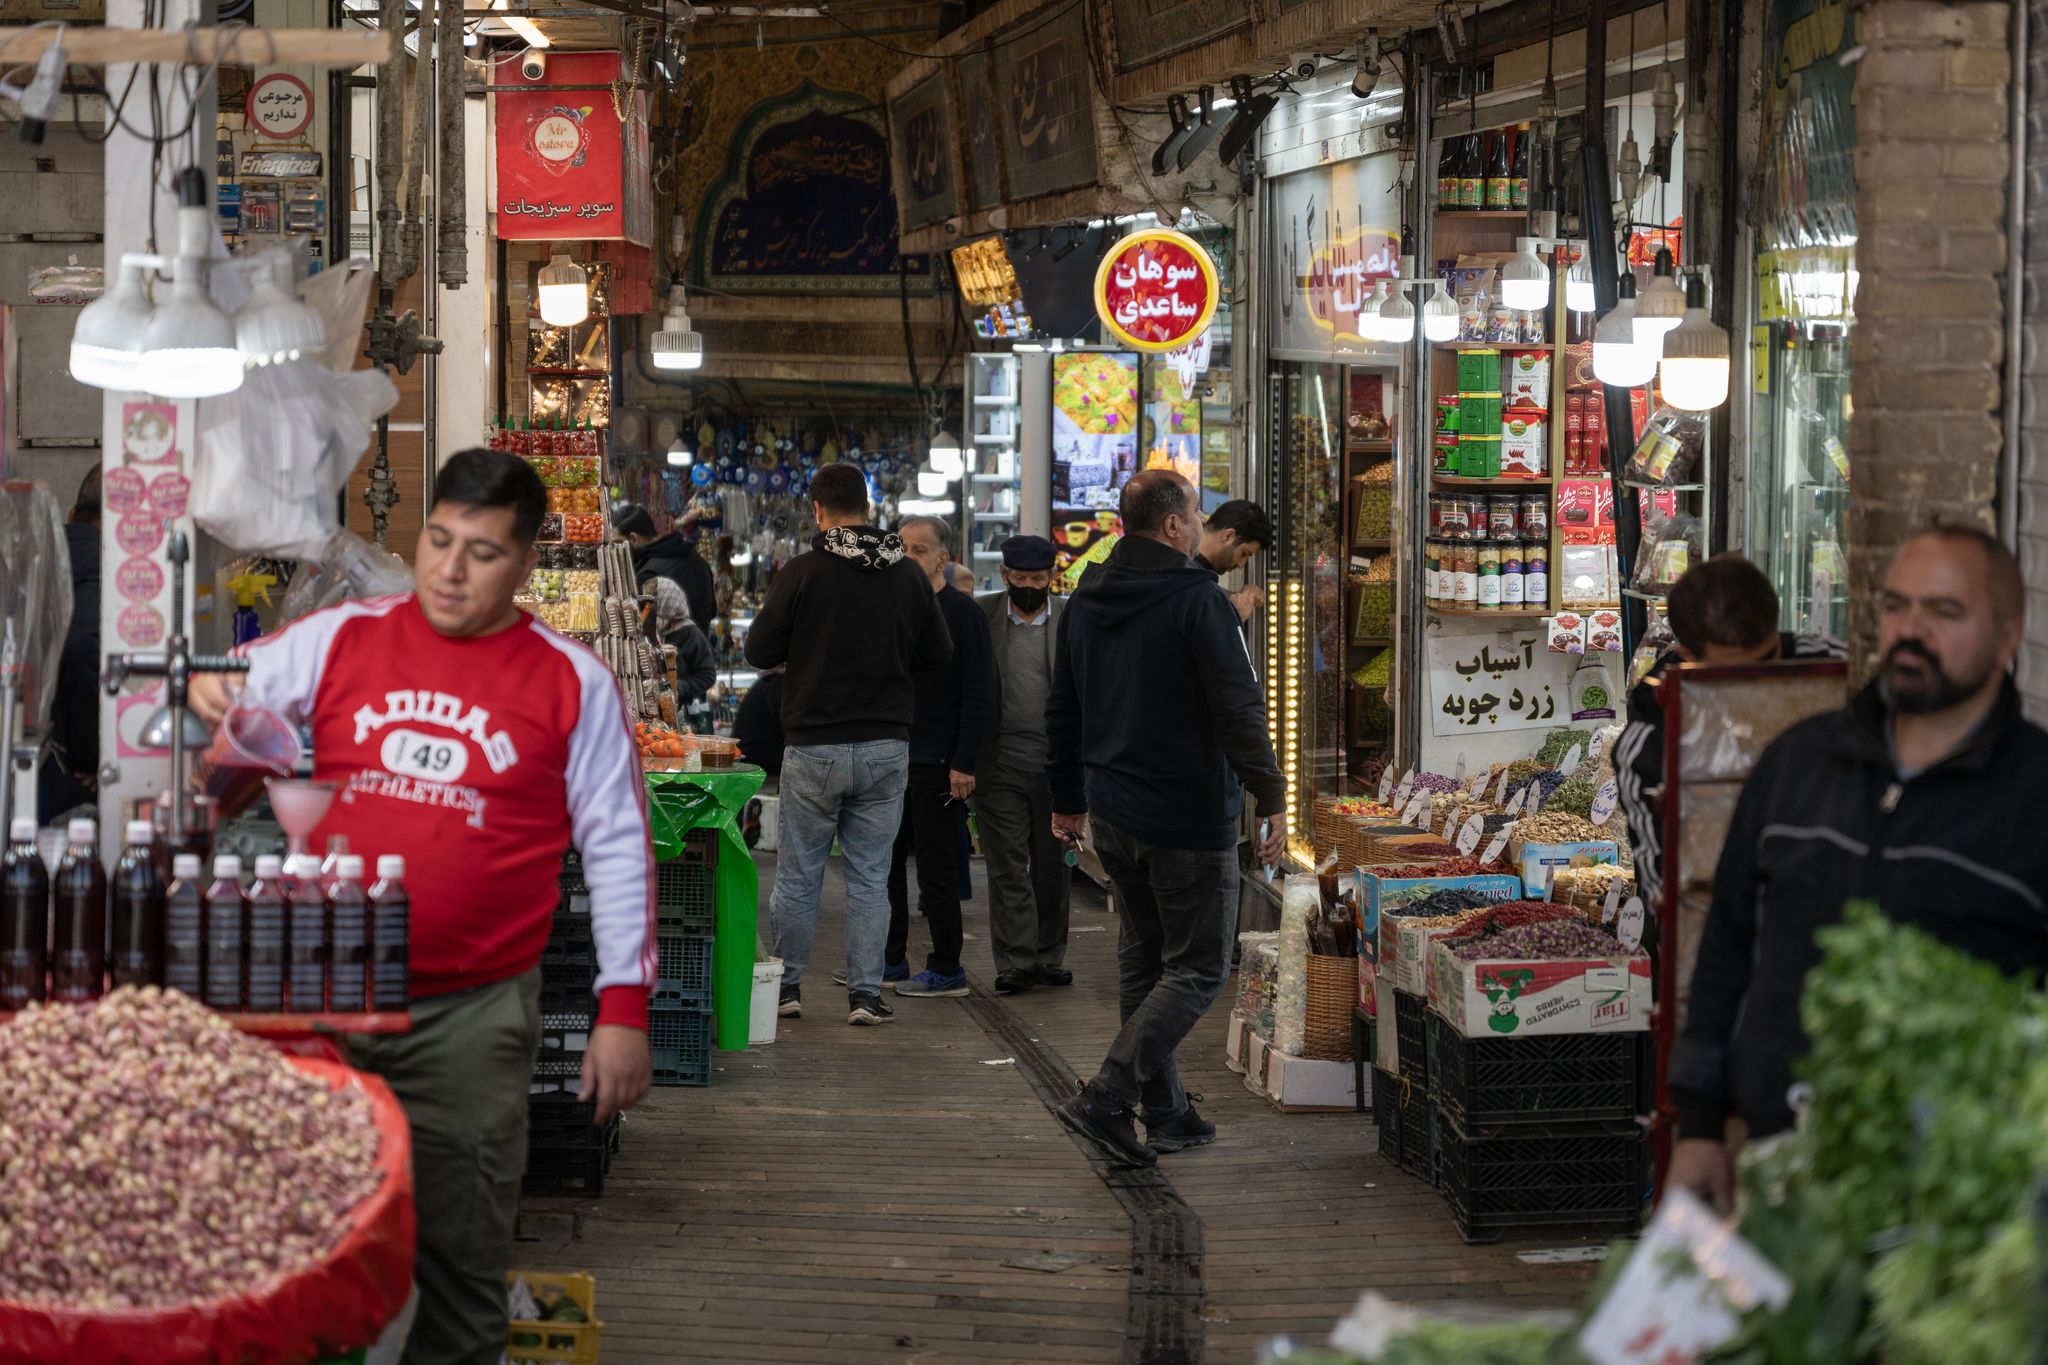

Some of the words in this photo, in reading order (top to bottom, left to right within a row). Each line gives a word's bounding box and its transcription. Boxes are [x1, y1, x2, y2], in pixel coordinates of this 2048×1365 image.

[258, 92, 303, 104] مرجوعی
[263, 108, 297, 122] نداریم
[547, 122, 567, 136] Mr
[240, 155, 320, 176] Energizer
[503, 198, 571, 218] سبزیجات
[576, 202, 614, 219] سوپر
[1115, 253, 1198, 288] سوهان
[1115, 291, 1198, 324] ساعدی
[1455, 637, 1537, 683] آسیاب
[1442, 691, 1501, 726] چوبه
[1508, 684, 1555, 721] زرد
[353, 688, 519, 775] ADIDAS
[412, 744, 453, 772] 49
[349, 768, 480, 813] ATHLETICS
[1477, 879, 1507, 887] SUPER
[1535, 995, 1564, 1013] HERBS
[1593, 1000, 1629, 1020] Tiar
